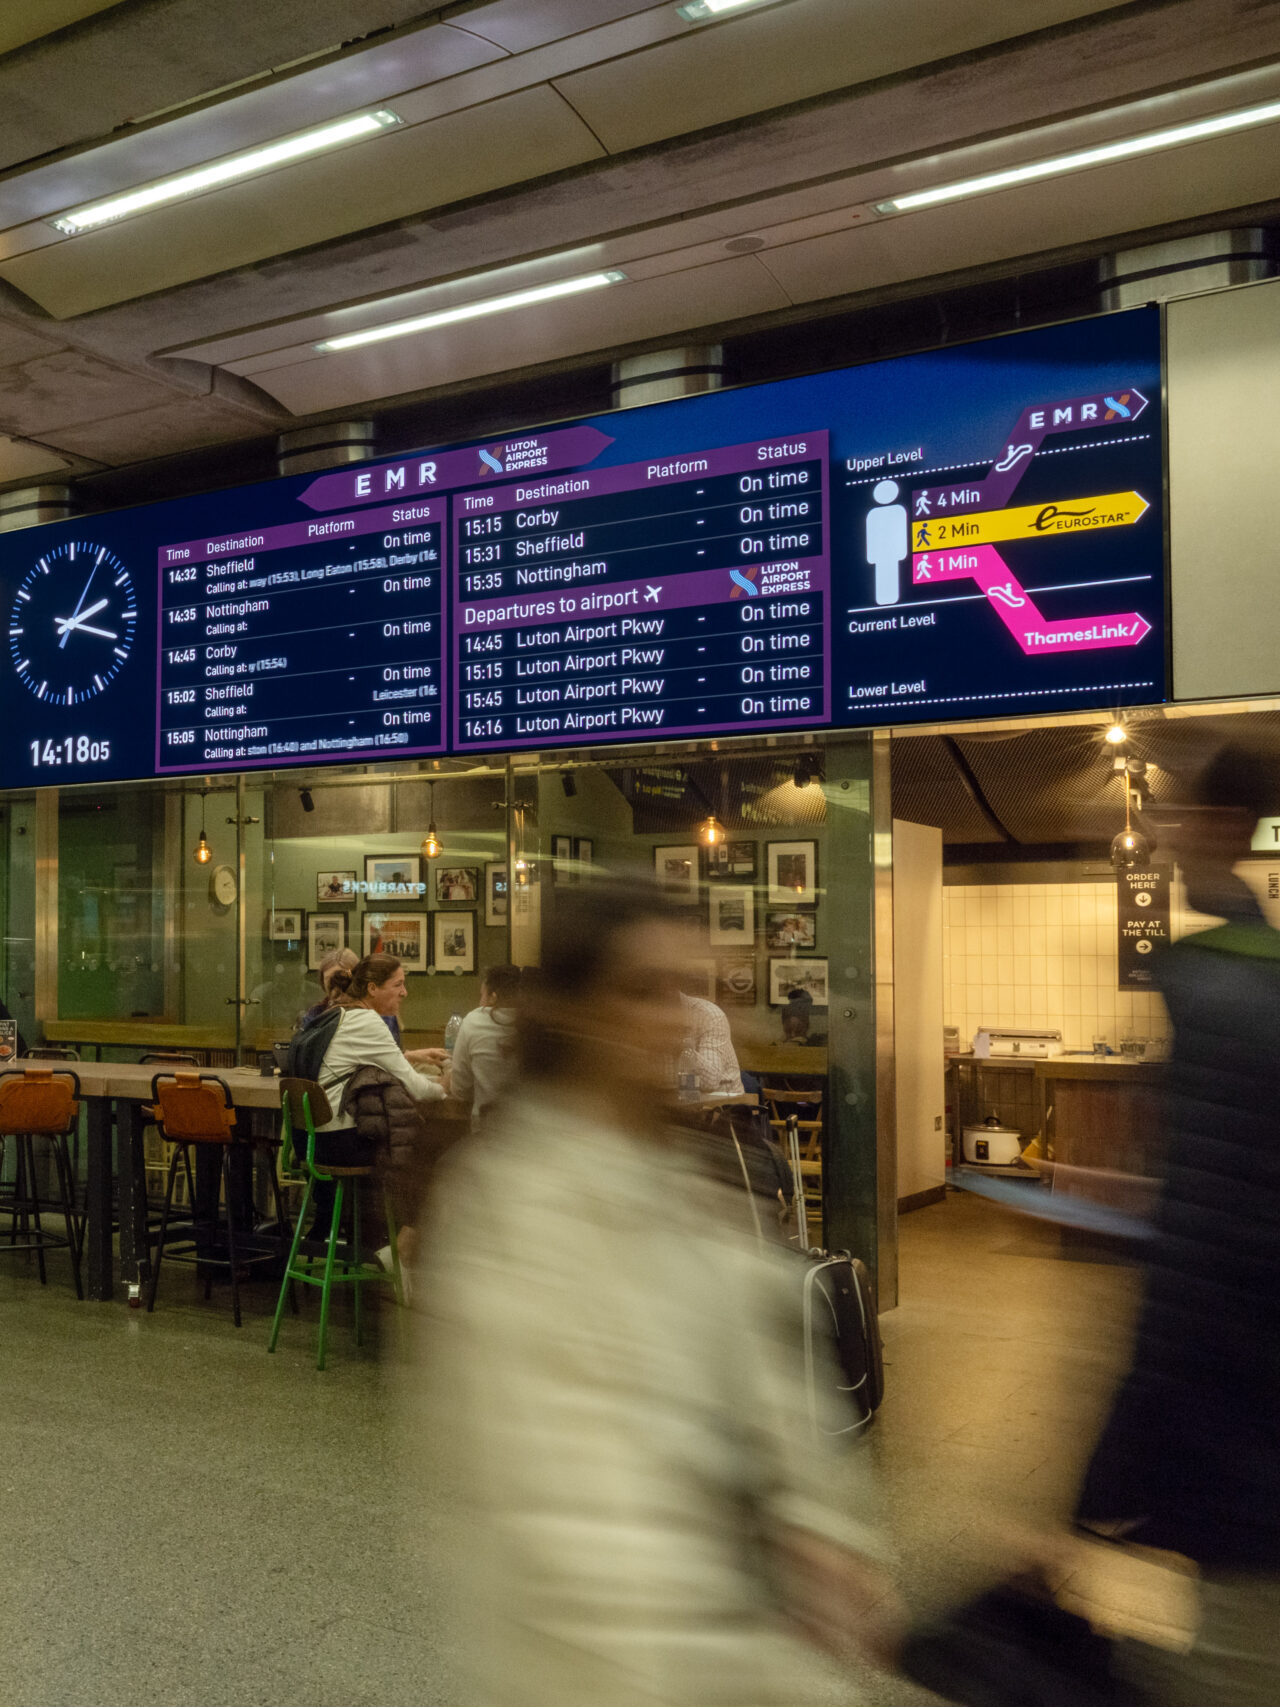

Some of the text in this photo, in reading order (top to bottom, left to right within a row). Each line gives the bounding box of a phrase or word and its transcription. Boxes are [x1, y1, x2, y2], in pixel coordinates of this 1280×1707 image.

[1029, 403, 1098, 430] EMR
[505, 440, 537, 452] LUTON
[505, 447, 548, 462] AIRPORT
[846, 448, 923, 473] Upper Level
[355, 462, 437, 497] EMR
[465, 442, 807, 510] Time Destination Platform Status
[505, 457, 548, 472] EXPRESS
[465, 471, 808, 536] 15:15 Corby On time
[937, 490, 980, 507] 4 Min
[167, 507, 430, 561] Time Destination Platform Status
[465, 502, 809, 564] 15:31 Sheffield On time
[938, 523, 980, 539] 2 Min
[1057, 512, 1126, 530] EUROSTAR
[169, 532, 431, 583] 14:32 Sheffield On time
[465, 533, 809, 590] 15:35 Nottingham On time
[761, 562, 798, 574] LUTON
[938, 555, 978, 571] 1 Min
[761, 571, 811, 584] AIRPORT
[761, 581, 811, 594] EXPRESS
[169, 576, 431, 623] 14:35 Nottingham On time
[465, 588, 638, 624] Departures to airport
[465, 603, 810, 653] 14:45 Luton Airport Pkwy On time
[849, 613, 936, 633] Current Level
[168, 621, 431, 664] 14:45 Corby On time
[465, 634, 810, 681] 15:15 Luton Airport Pkwy On time
[168, 665, 431, 704] 15:02 Sheffield On time
[465, 665, 810, 708] 15:45 Luton Airport Pkwy On time
[849, 680, 926, 698] Lower Level
[167, 710, 431, 744] 15:05 Nottingham On time
[465, 696, 810, 737] 16:16 Luton Airport Pkwy On time
[1126, 873, 1160, 881] ORDER
[1268, 872, 1279, 899] LUNCH
